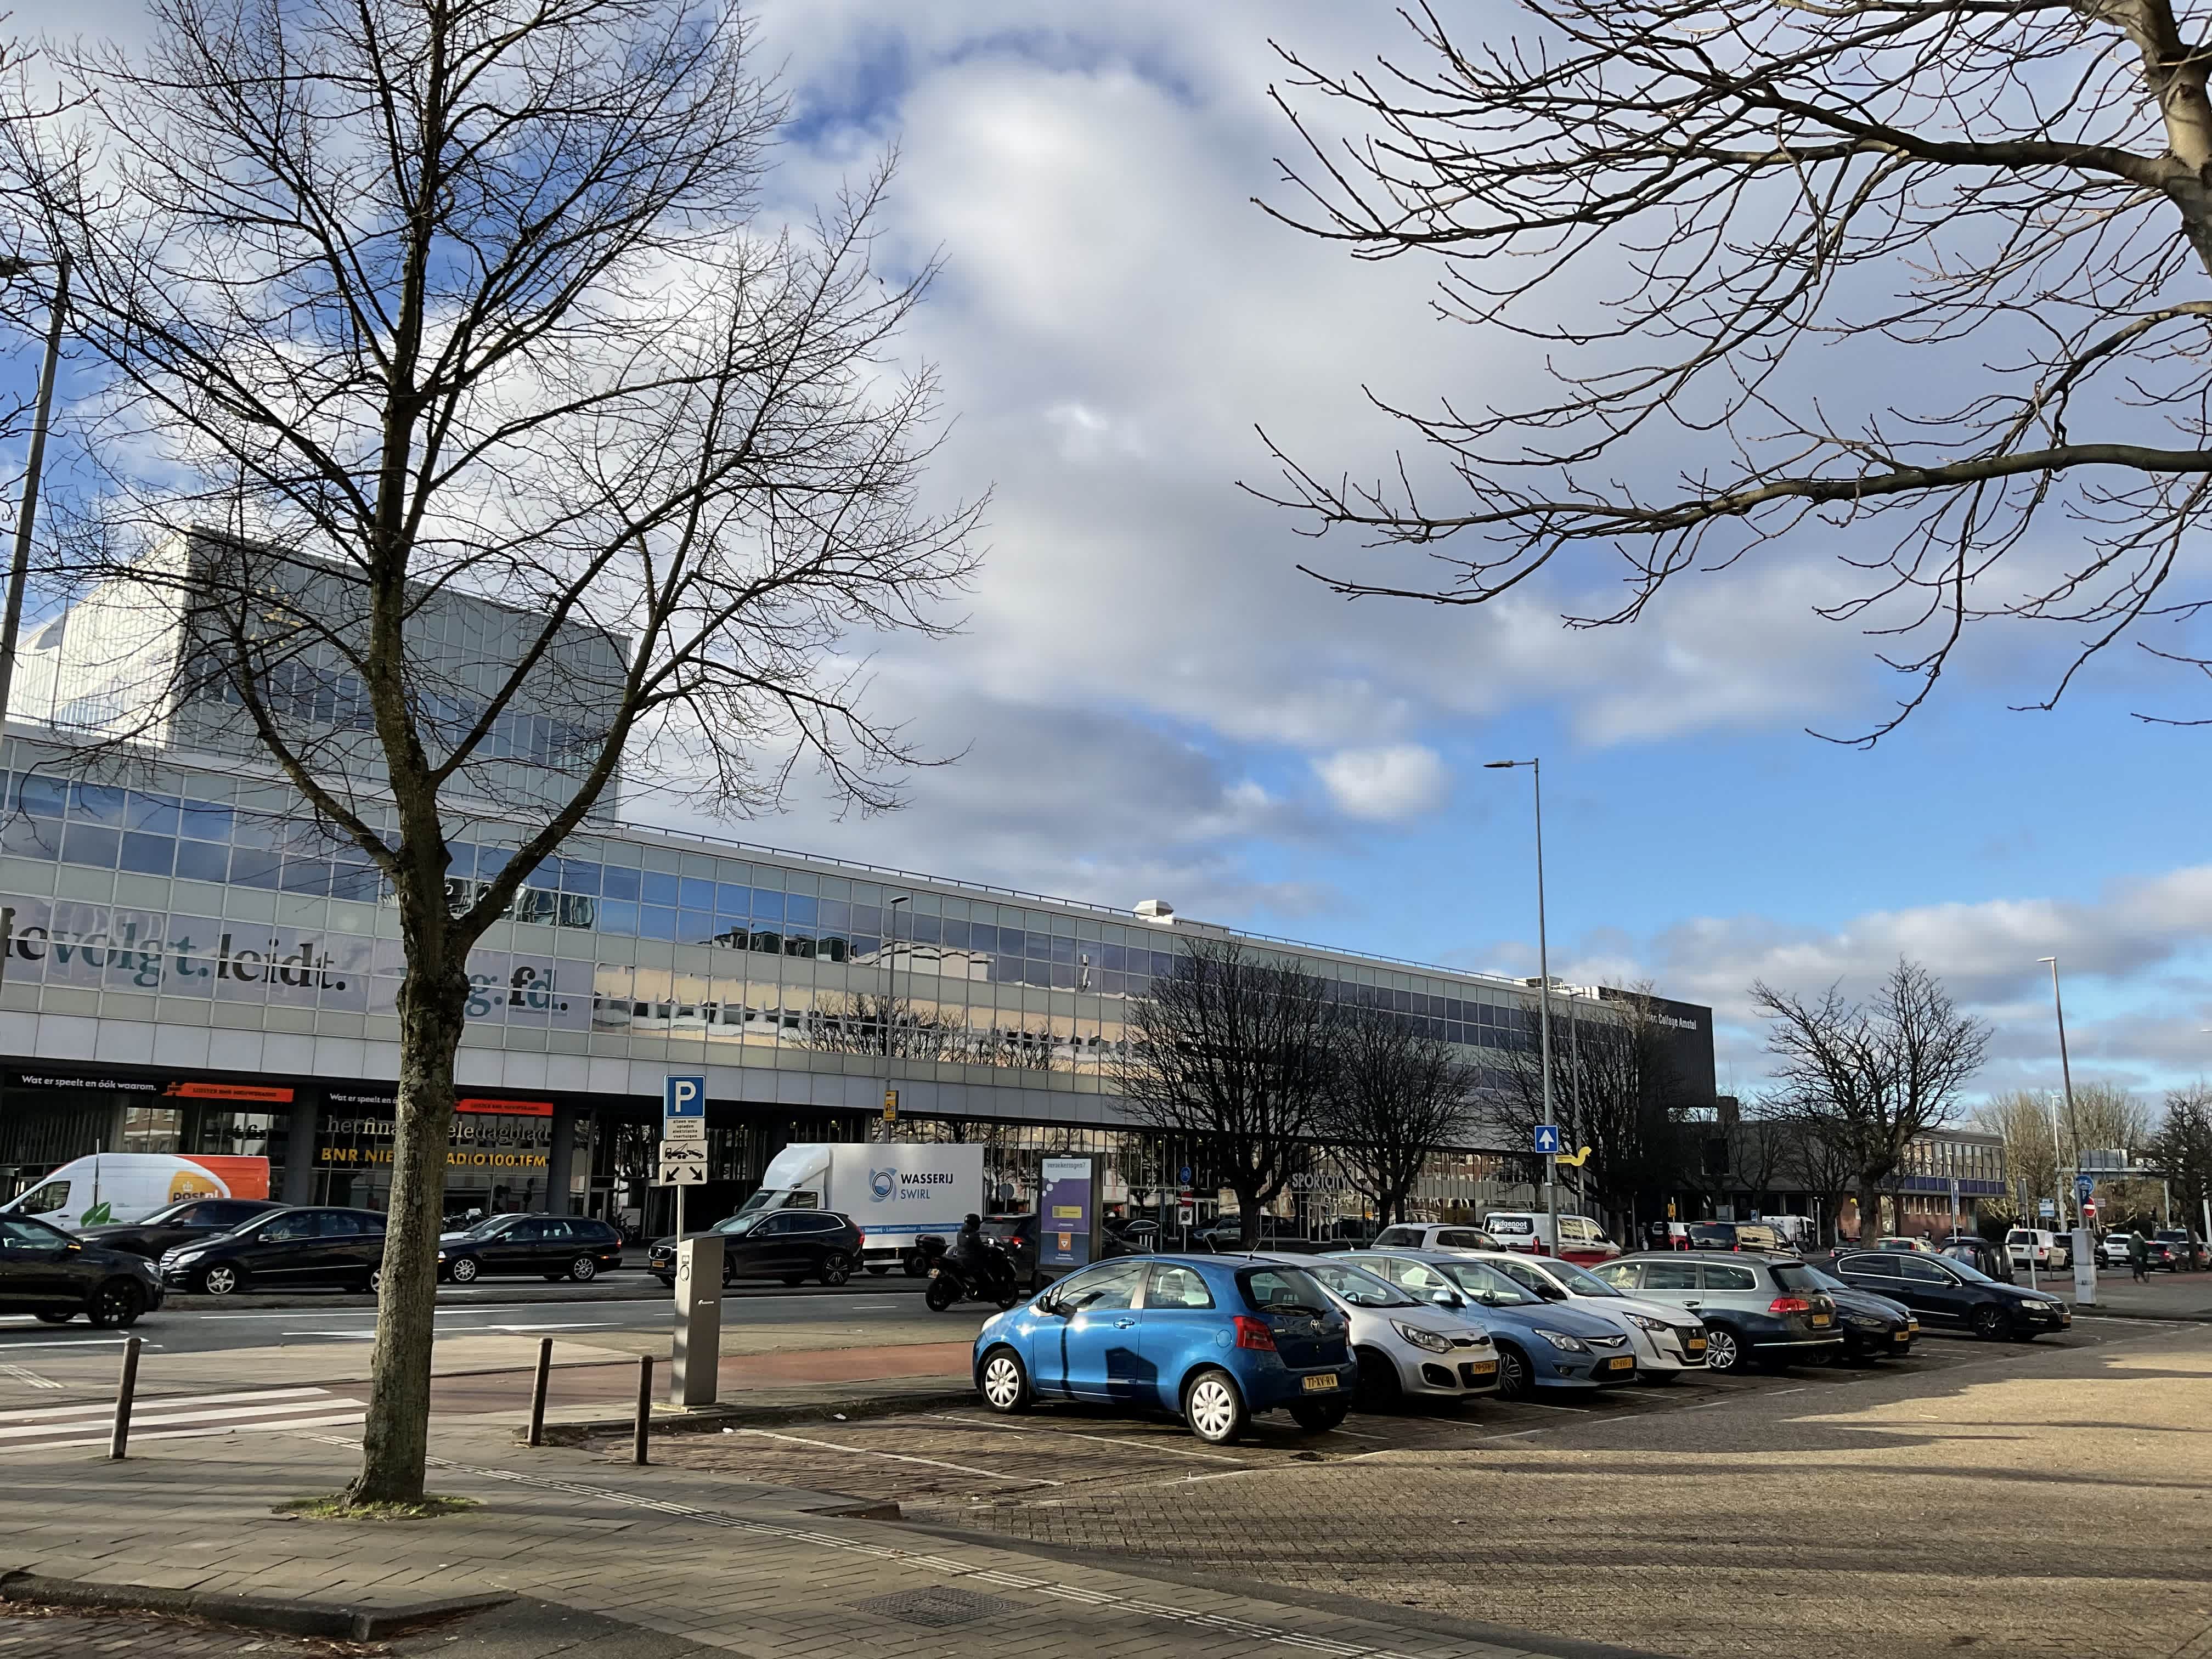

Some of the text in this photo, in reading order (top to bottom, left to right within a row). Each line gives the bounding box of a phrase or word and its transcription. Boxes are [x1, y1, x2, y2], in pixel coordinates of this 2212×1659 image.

[1658, 1013, 1678, 1028] College
[1679, 1017, 1697, 1030] Amstel
[22, 1075, 42, 1084] Wat
[55, 1079, 83, 1087] speelt
[330, 1093, 346, 1101] Wat
[675, 1081, 696, 1112] P
[321, 1148, 358, 1161] BNR
[900, 1173, 953, 1185] WASSERIJ
[1292, 1172, 1348, 1190] SPORTCITY
[900, 1188, 930, 1200] SWIRL
[1490, 1220, 1527, 1228] Stadgenoot
